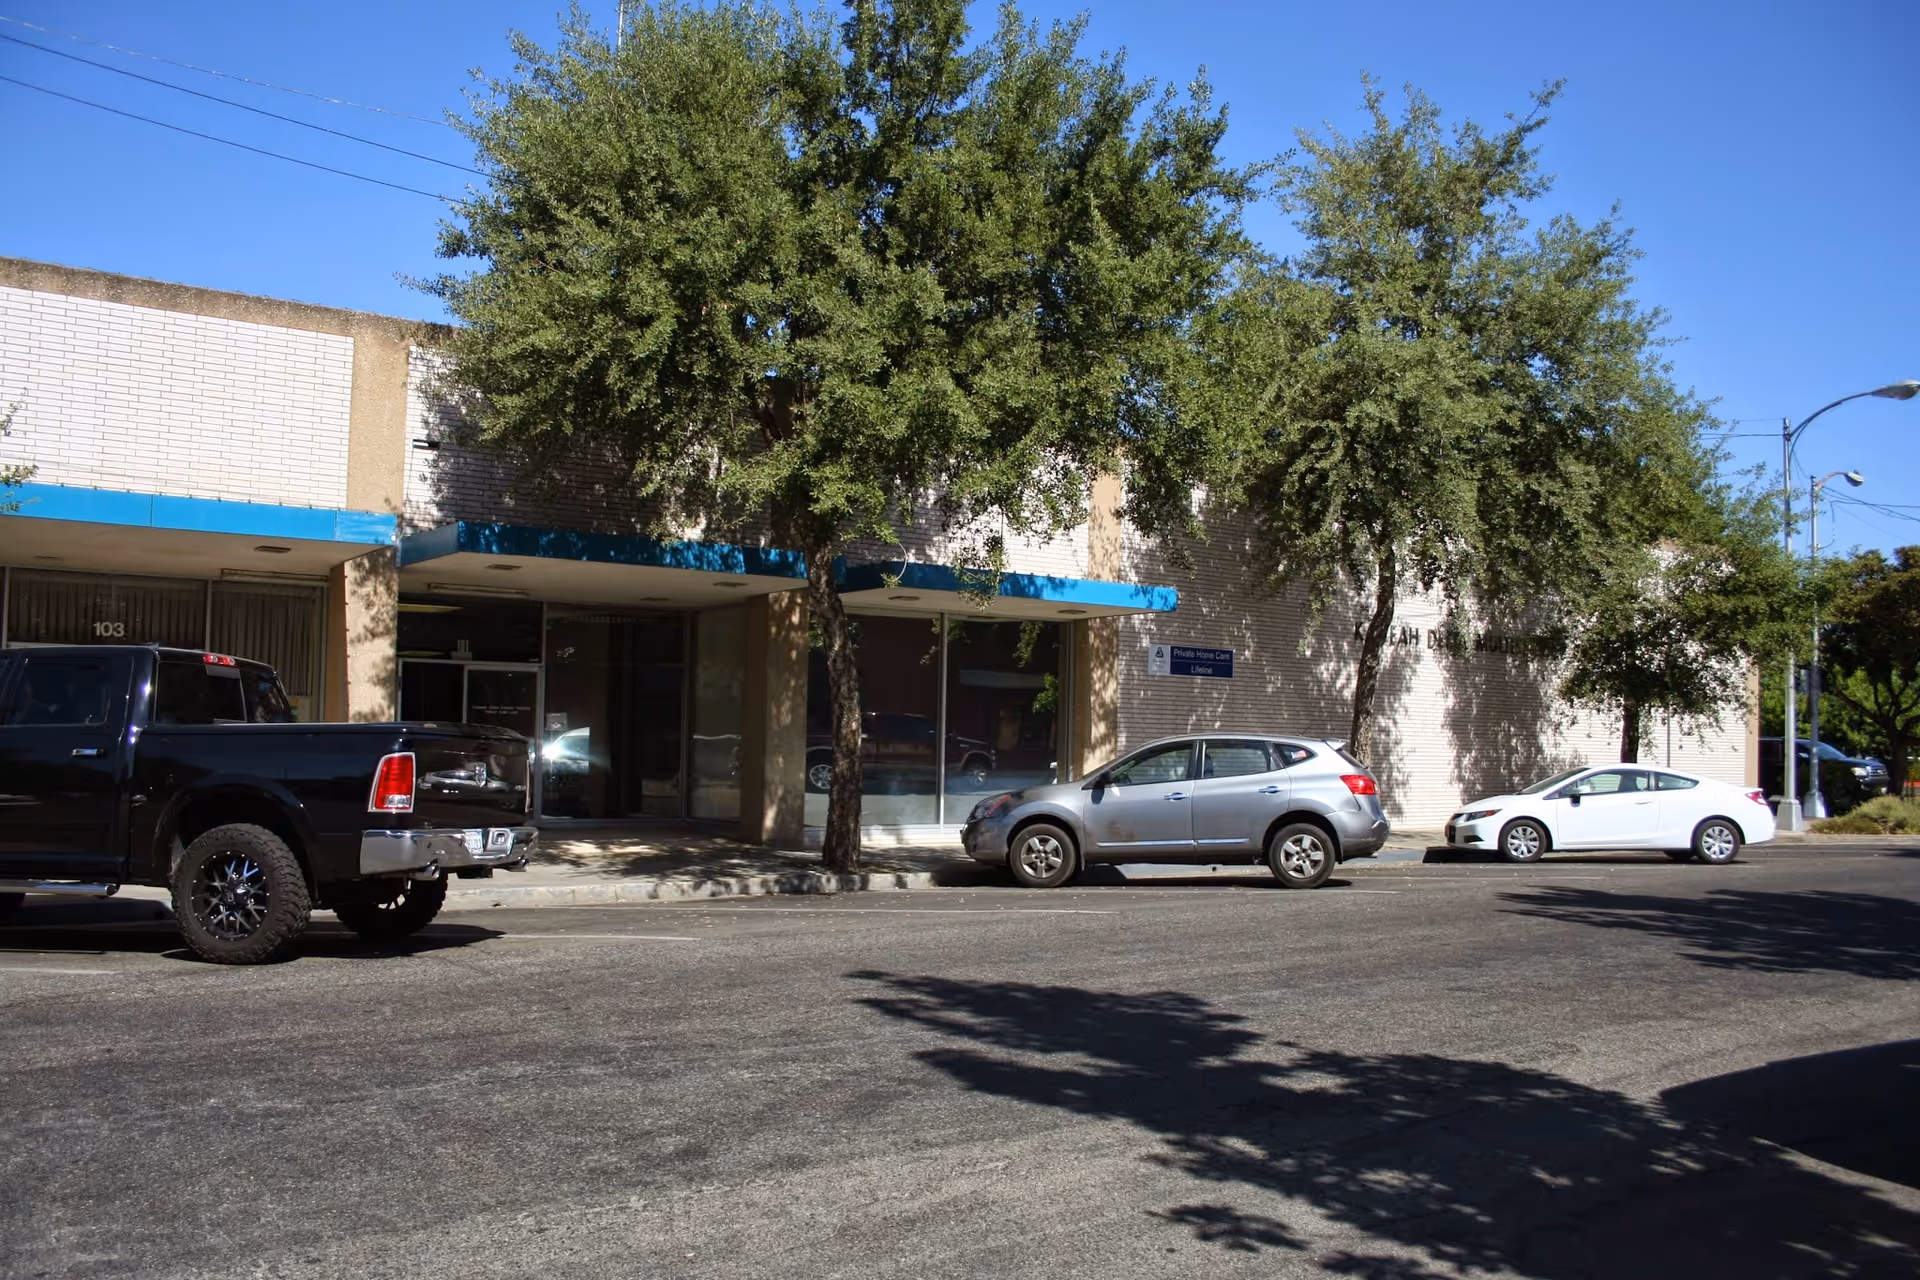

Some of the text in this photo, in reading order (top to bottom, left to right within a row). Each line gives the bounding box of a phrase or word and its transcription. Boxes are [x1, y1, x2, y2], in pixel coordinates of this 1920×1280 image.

[93, 622, 125, 637] 103
[1173, 648, 1230, 660] Private Home Care
[1191, 665, 1213, 674] Lifeline
